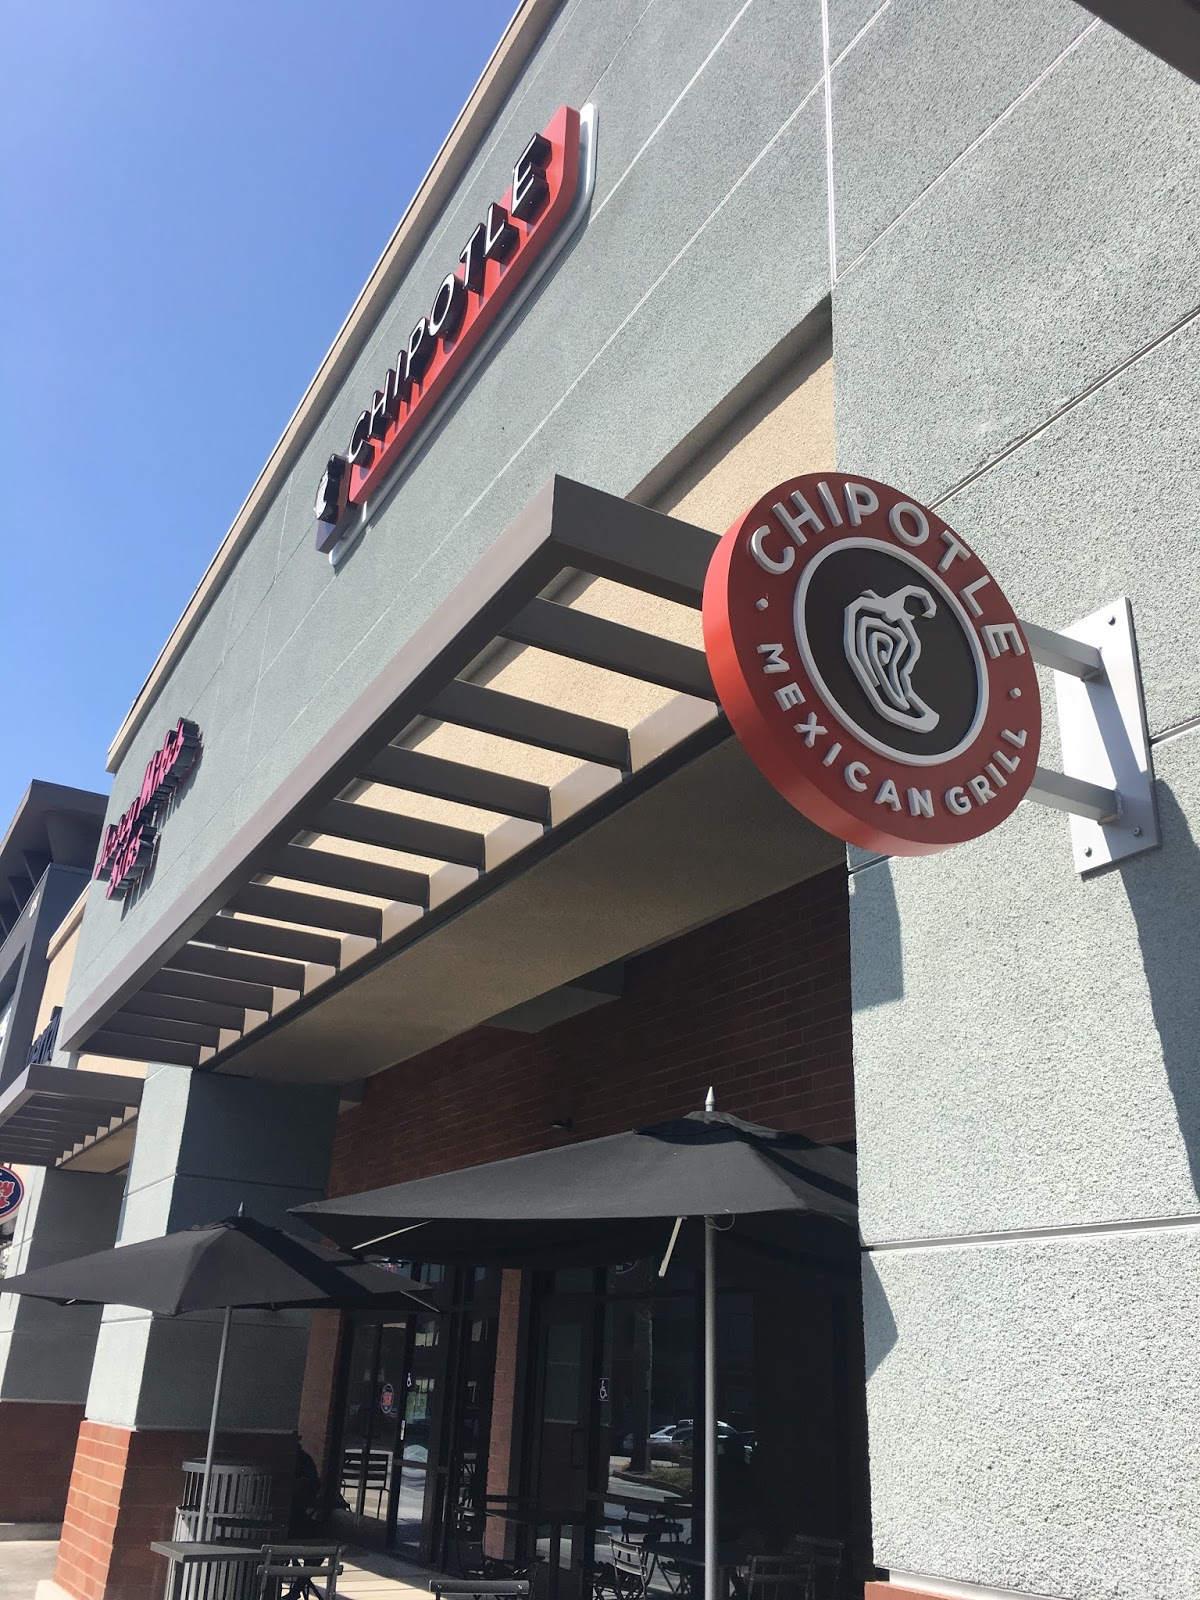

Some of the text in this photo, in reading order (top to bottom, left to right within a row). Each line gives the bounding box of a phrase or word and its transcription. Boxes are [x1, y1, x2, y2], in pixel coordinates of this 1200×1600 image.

[347, 131, 552, 466] CHIPOTLE
[749, 480, 1026, 660] CHIPOTLE
[756, 642, 1028, 818] MEXICAN GRILL
